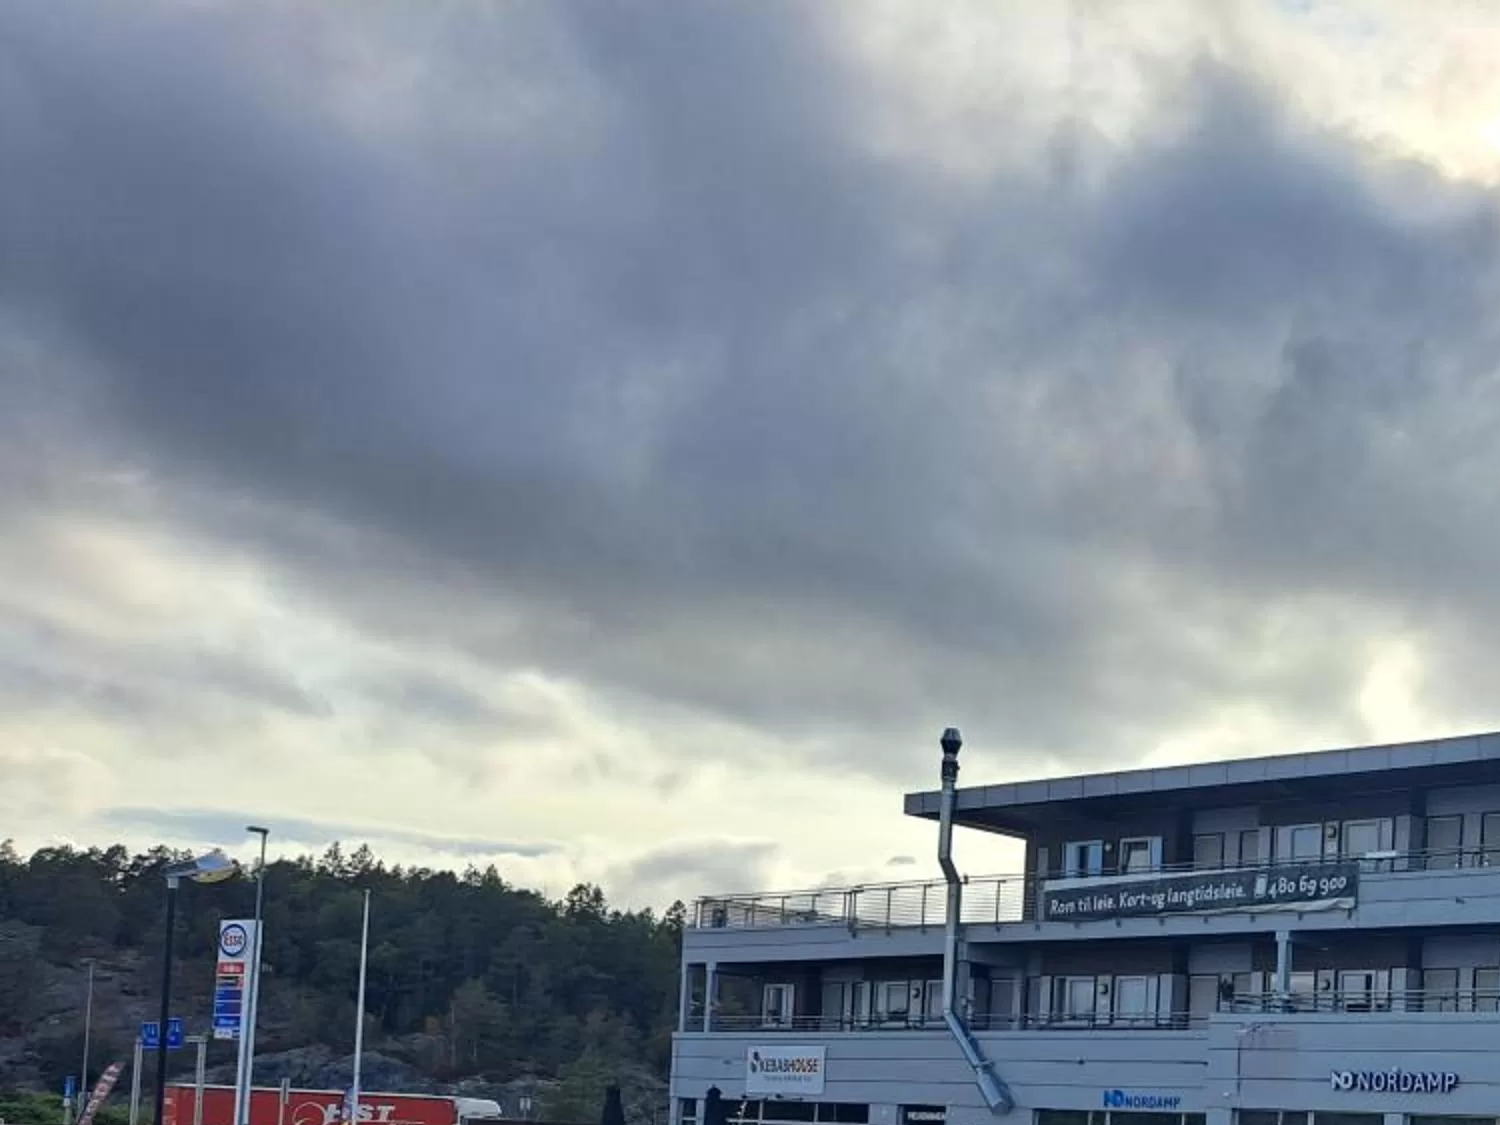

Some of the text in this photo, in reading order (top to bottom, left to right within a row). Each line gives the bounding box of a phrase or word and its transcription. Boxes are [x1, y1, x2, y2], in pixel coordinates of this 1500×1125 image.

[1050, 899, 1074, 914] Rom
[1078, 897, 1091, 912] til
[1268, 878, 1296, 899] 480
[1299, 875, 1316, 896] 69
[1320, 876, 1347, 896] 900
[1356, 1071, 1459, 1093] NORDAMP
